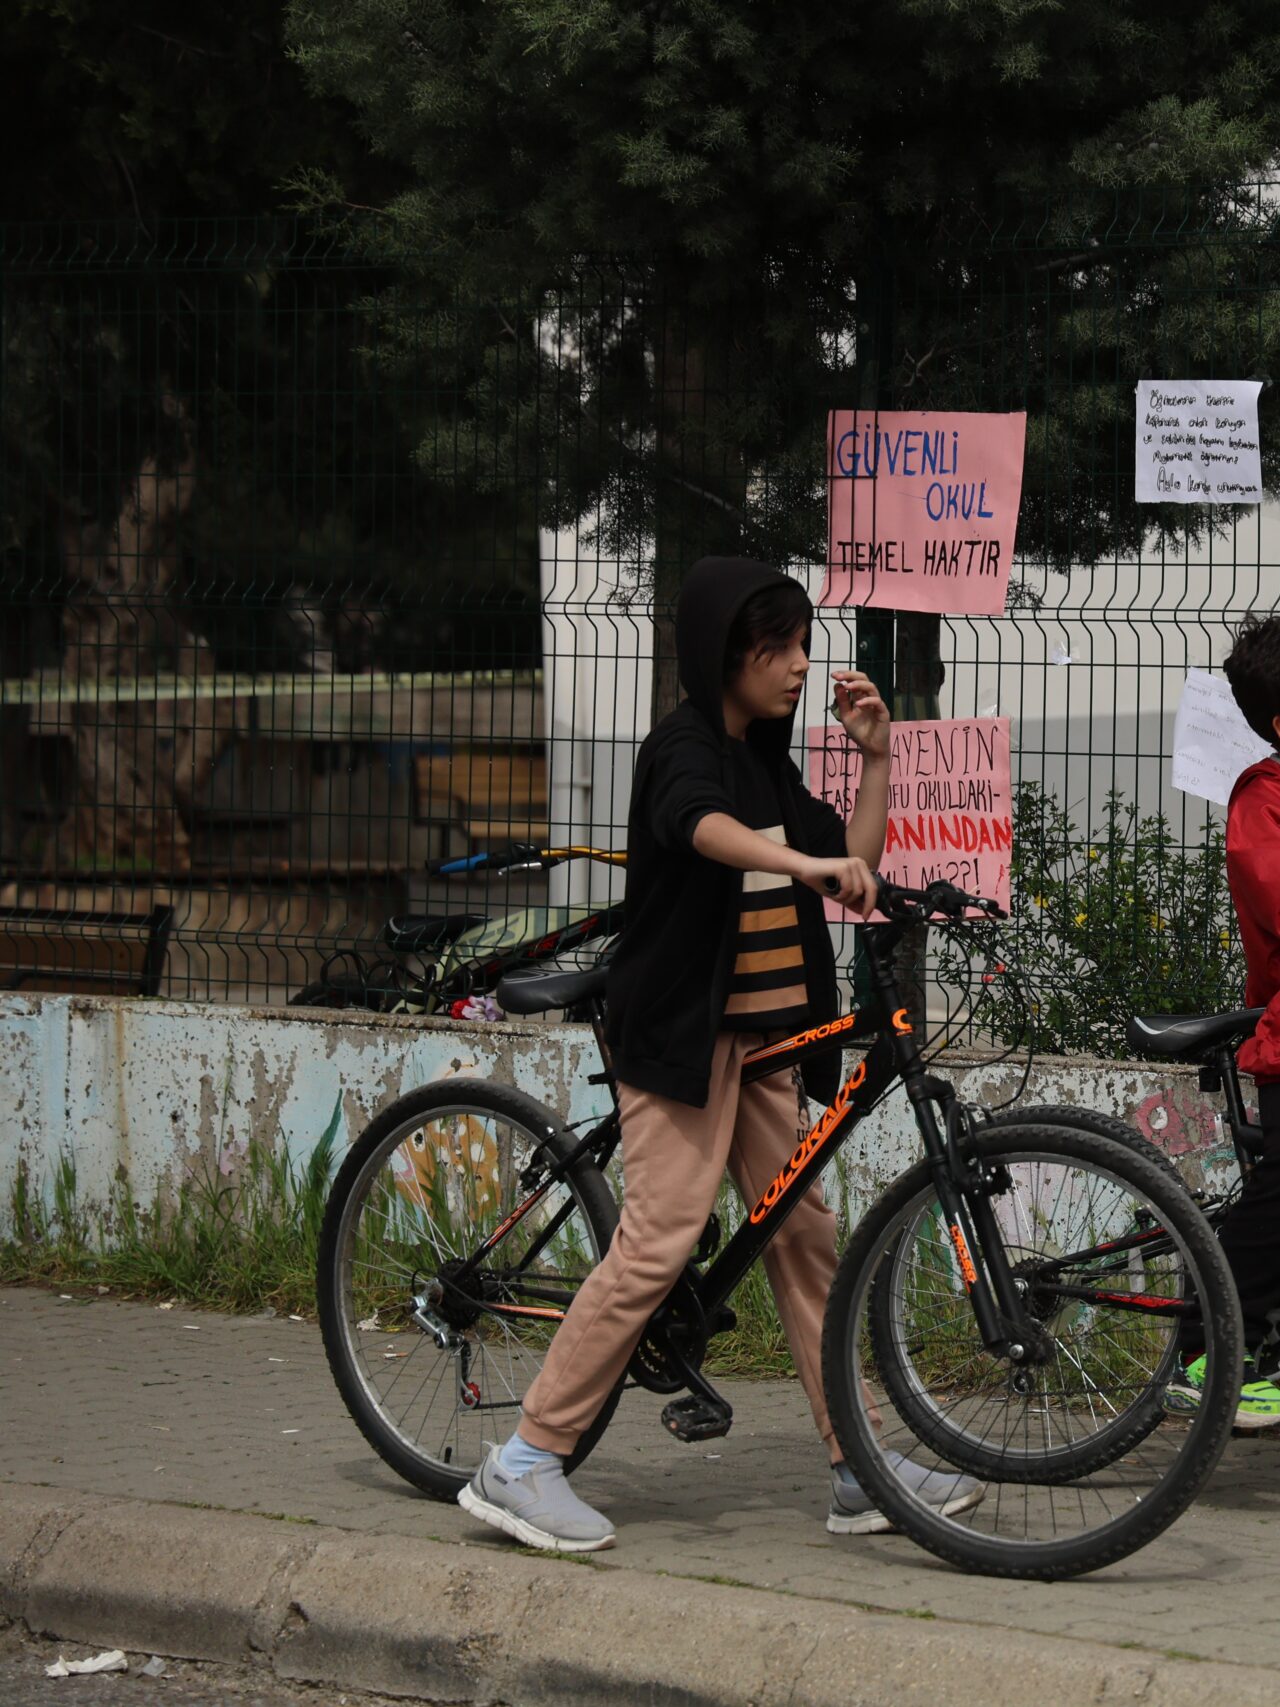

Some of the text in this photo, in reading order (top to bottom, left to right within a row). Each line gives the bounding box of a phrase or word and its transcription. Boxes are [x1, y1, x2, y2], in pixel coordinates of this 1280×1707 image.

[836, 424, 959, 477] GÜVENLİ
[926, 481, 993, 521] OKUL
[837, 540, 1001, 577] TEMEL HAKTIR
[793, 1013, 856, 1047] CROSS
[750, 1060, 867, 1226] COLORADO
